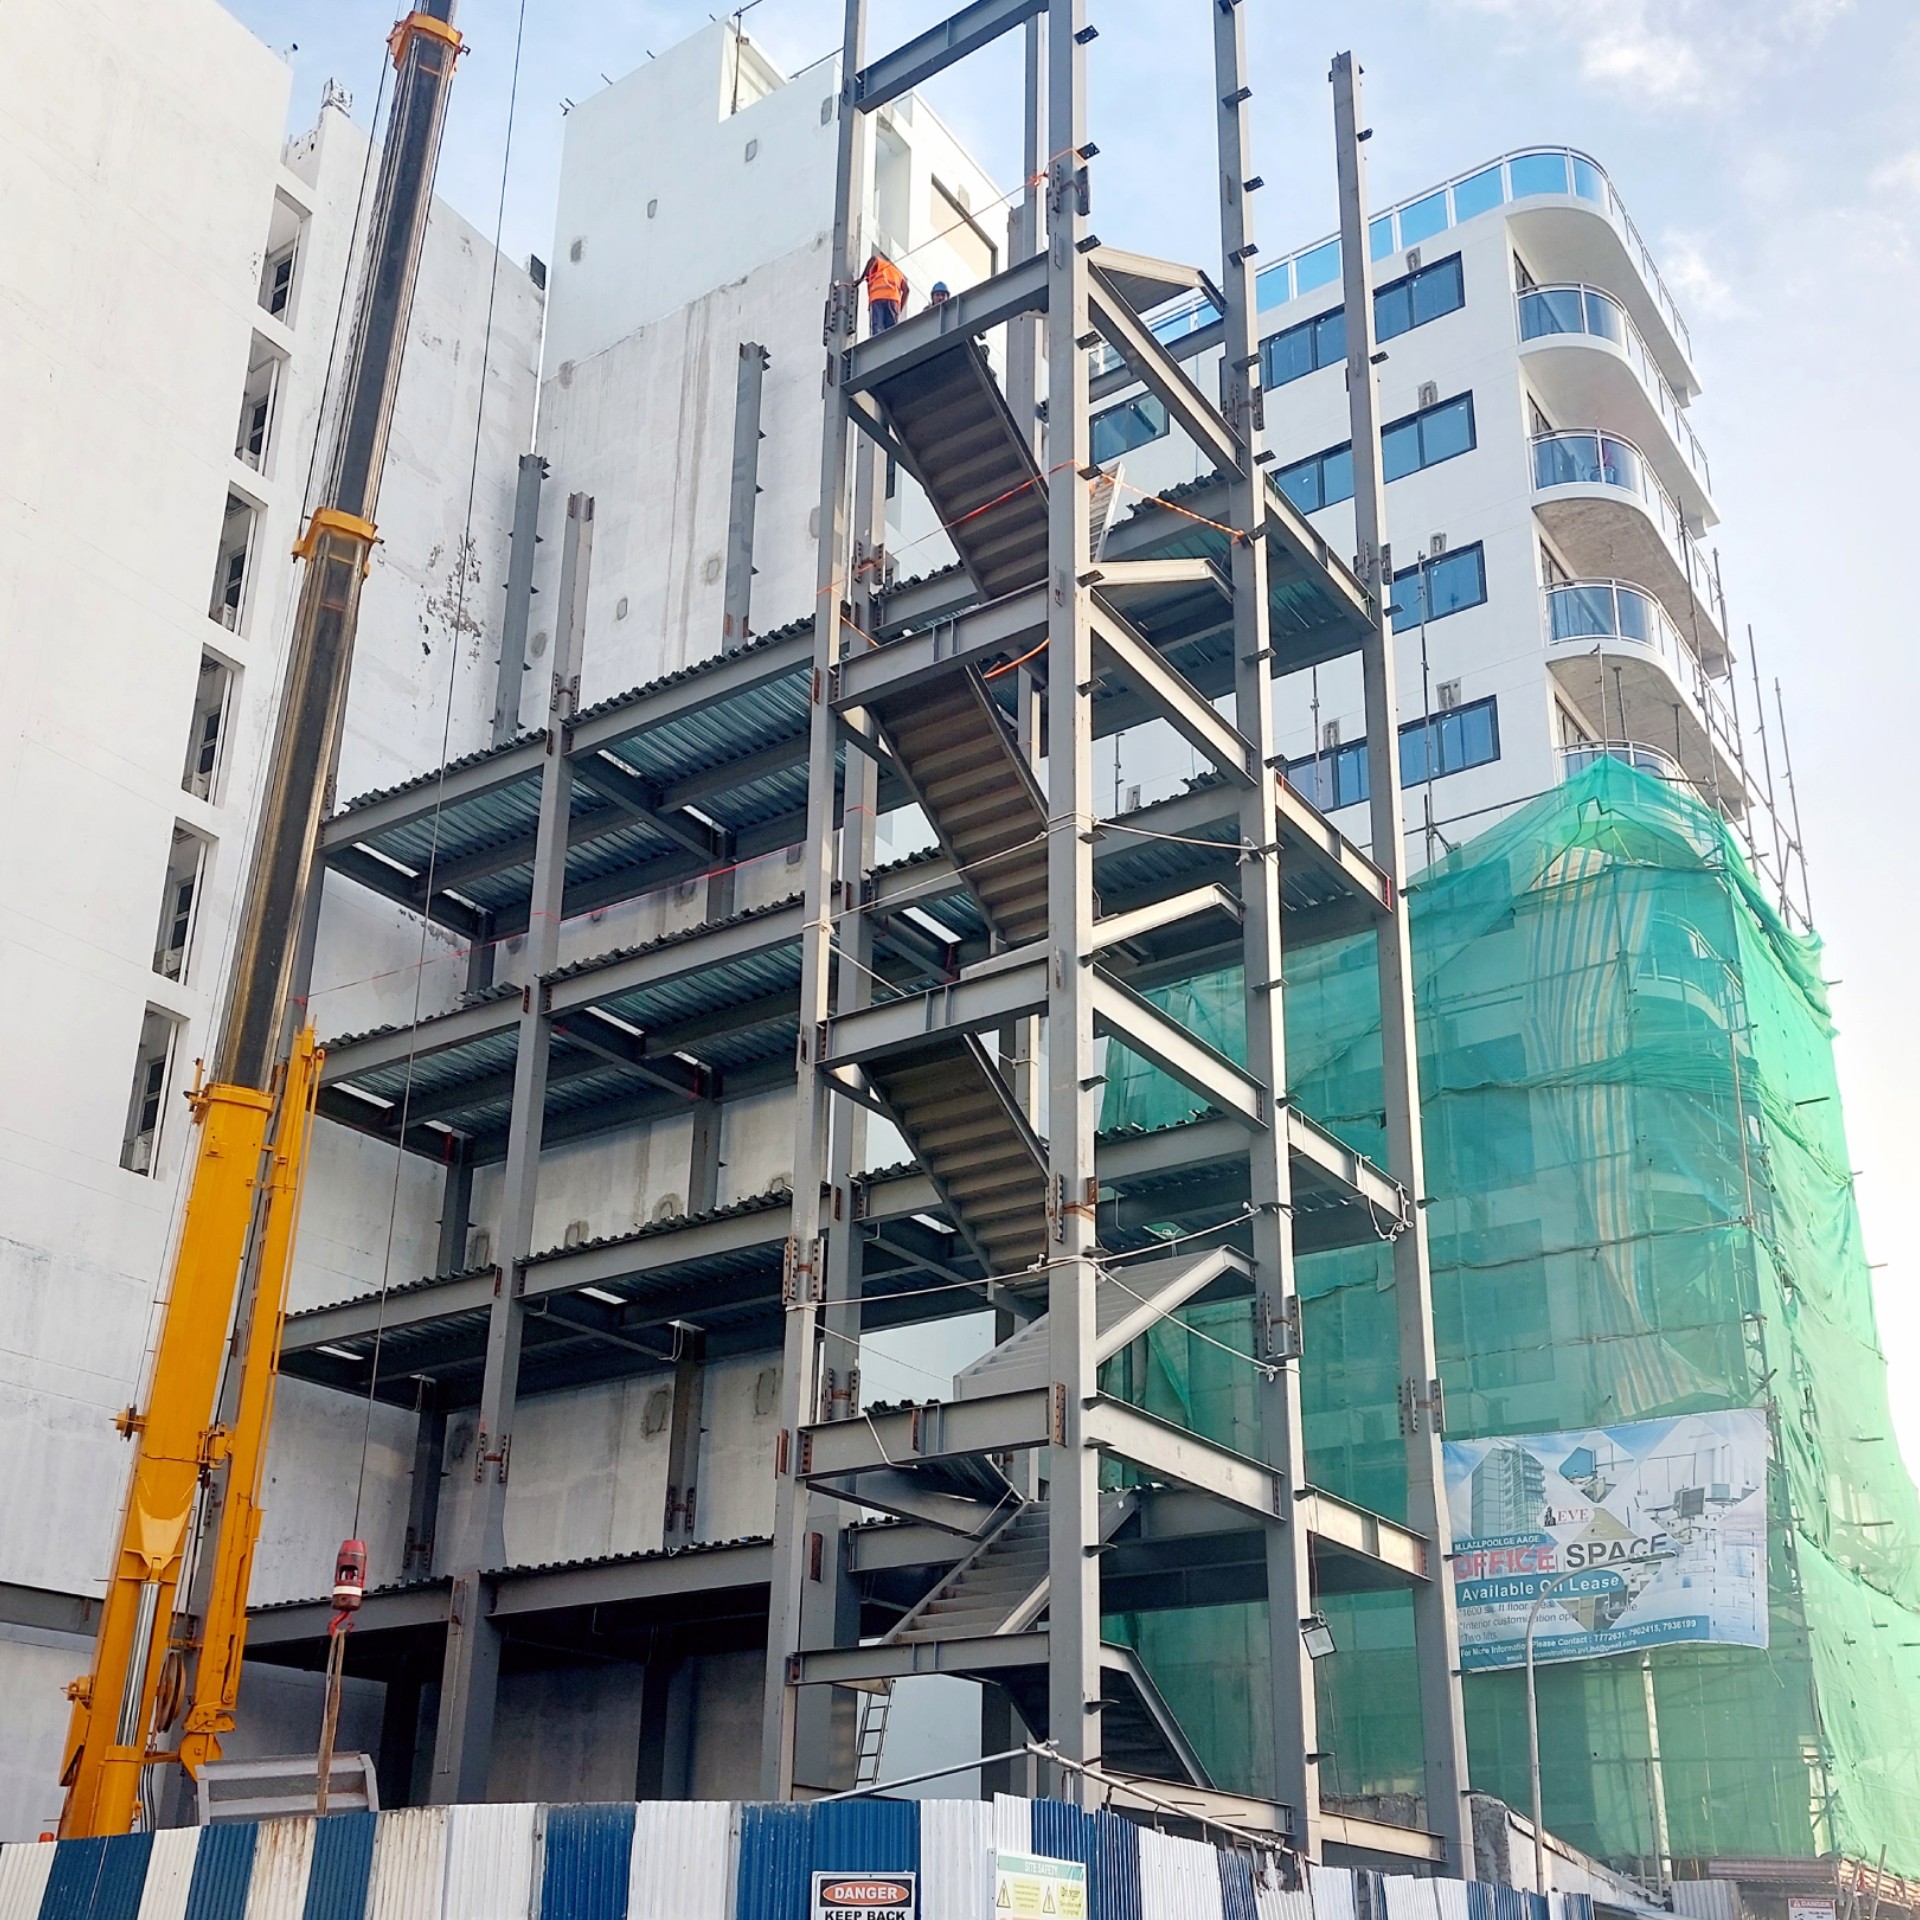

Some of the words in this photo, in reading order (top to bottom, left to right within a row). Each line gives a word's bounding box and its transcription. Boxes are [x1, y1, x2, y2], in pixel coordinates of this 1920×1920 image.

[1557, 1508, 1589, 1522] EVE
[1516, 1535, 1541, 1545] AAGE
[1453, 1547, 1556, 1580] OFFICE
[1566, 1533, 1667, 1568] SPACE
[1462, 1581, 1534, 1601] Available
[1569, 1575, 1620, 1592] Lease
[1507, 1602, 1528, 1612] floor
[1531, 1601, 1555, 1610] aea
[1460, 1649, 1472, 1658] For
[1491, 1642, 1528, 1654] Informatio
[1532, 1639, 1556, 1649] Please
[1557, 1636, 1588, 1647] Contact
[1024, 1860, 1037, 1874] SITE
[1037, 1862, 1058, 1877] SAFETY
[834, 1886, 898, 1900] DANGER
[825, 1910, 862, 1920] KEEP
[867, 1910, 906, 1920] BACK
